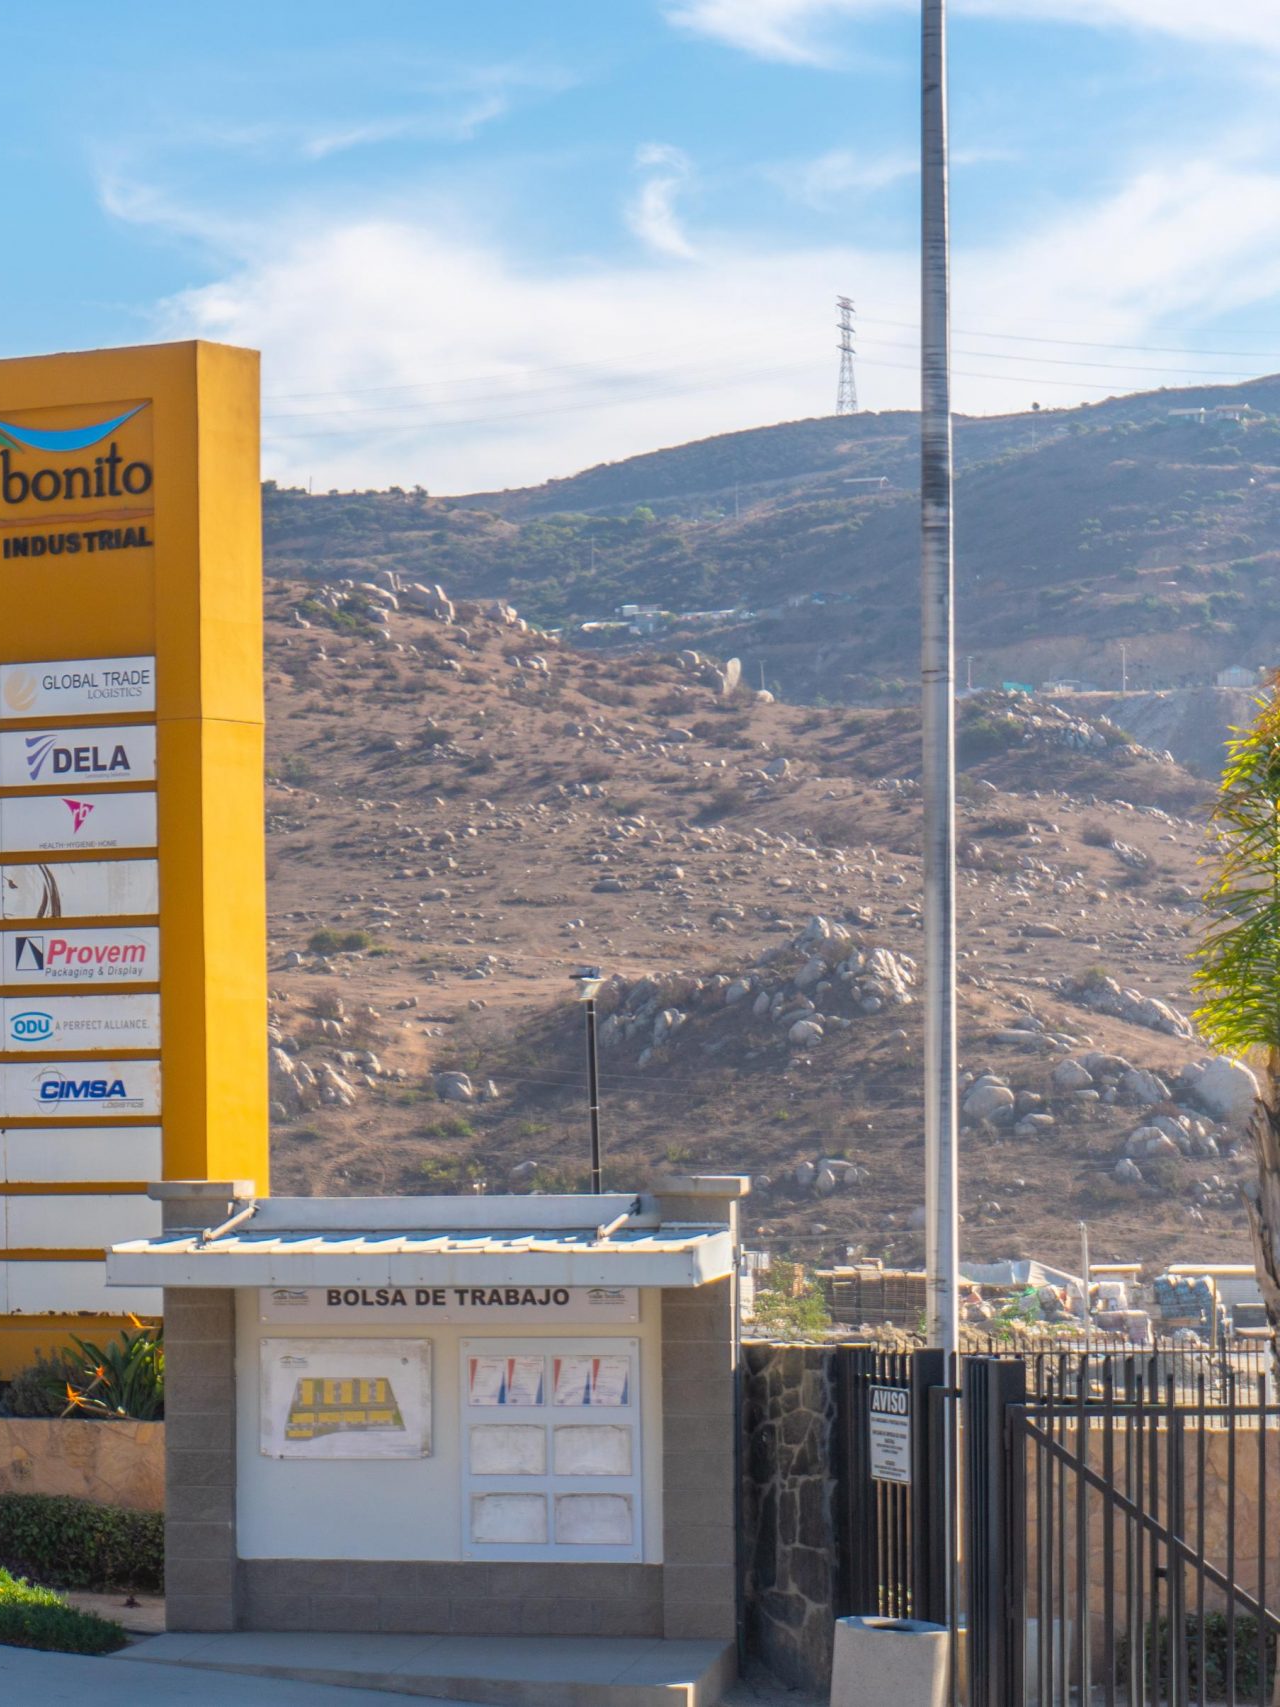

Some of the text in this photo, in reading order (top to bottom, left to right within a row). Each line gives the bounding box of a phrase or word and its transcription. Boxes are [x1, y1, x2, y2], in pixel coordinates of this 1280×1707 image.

[0, 441, 153, 505] bonito
[3, 526, 153, 561] INDUSTRIAL
[42, 669, 150, 691] GLOBAL TRADE
[87, 686, 143, 700] LOGISTICS
[52, 744, 131, 774] DELA
[46, 938, 146, 965] Provem
[45, 964, 143, 979] Packaging & Display
[14, 1019, 50, 1035] ODU
[55, 1022, 61, 1031] A
[63, 1020, 101, 1031] PERFECT
[40, 1079, 127, 1099] CIMSA
[326, 1289, 407, 1306] BOLSA
[415, 1288, 445, 1306] DE
[454, 1289, 570, 1306] TRABAJO
[872, 1390, 906, 1413] AVISO
